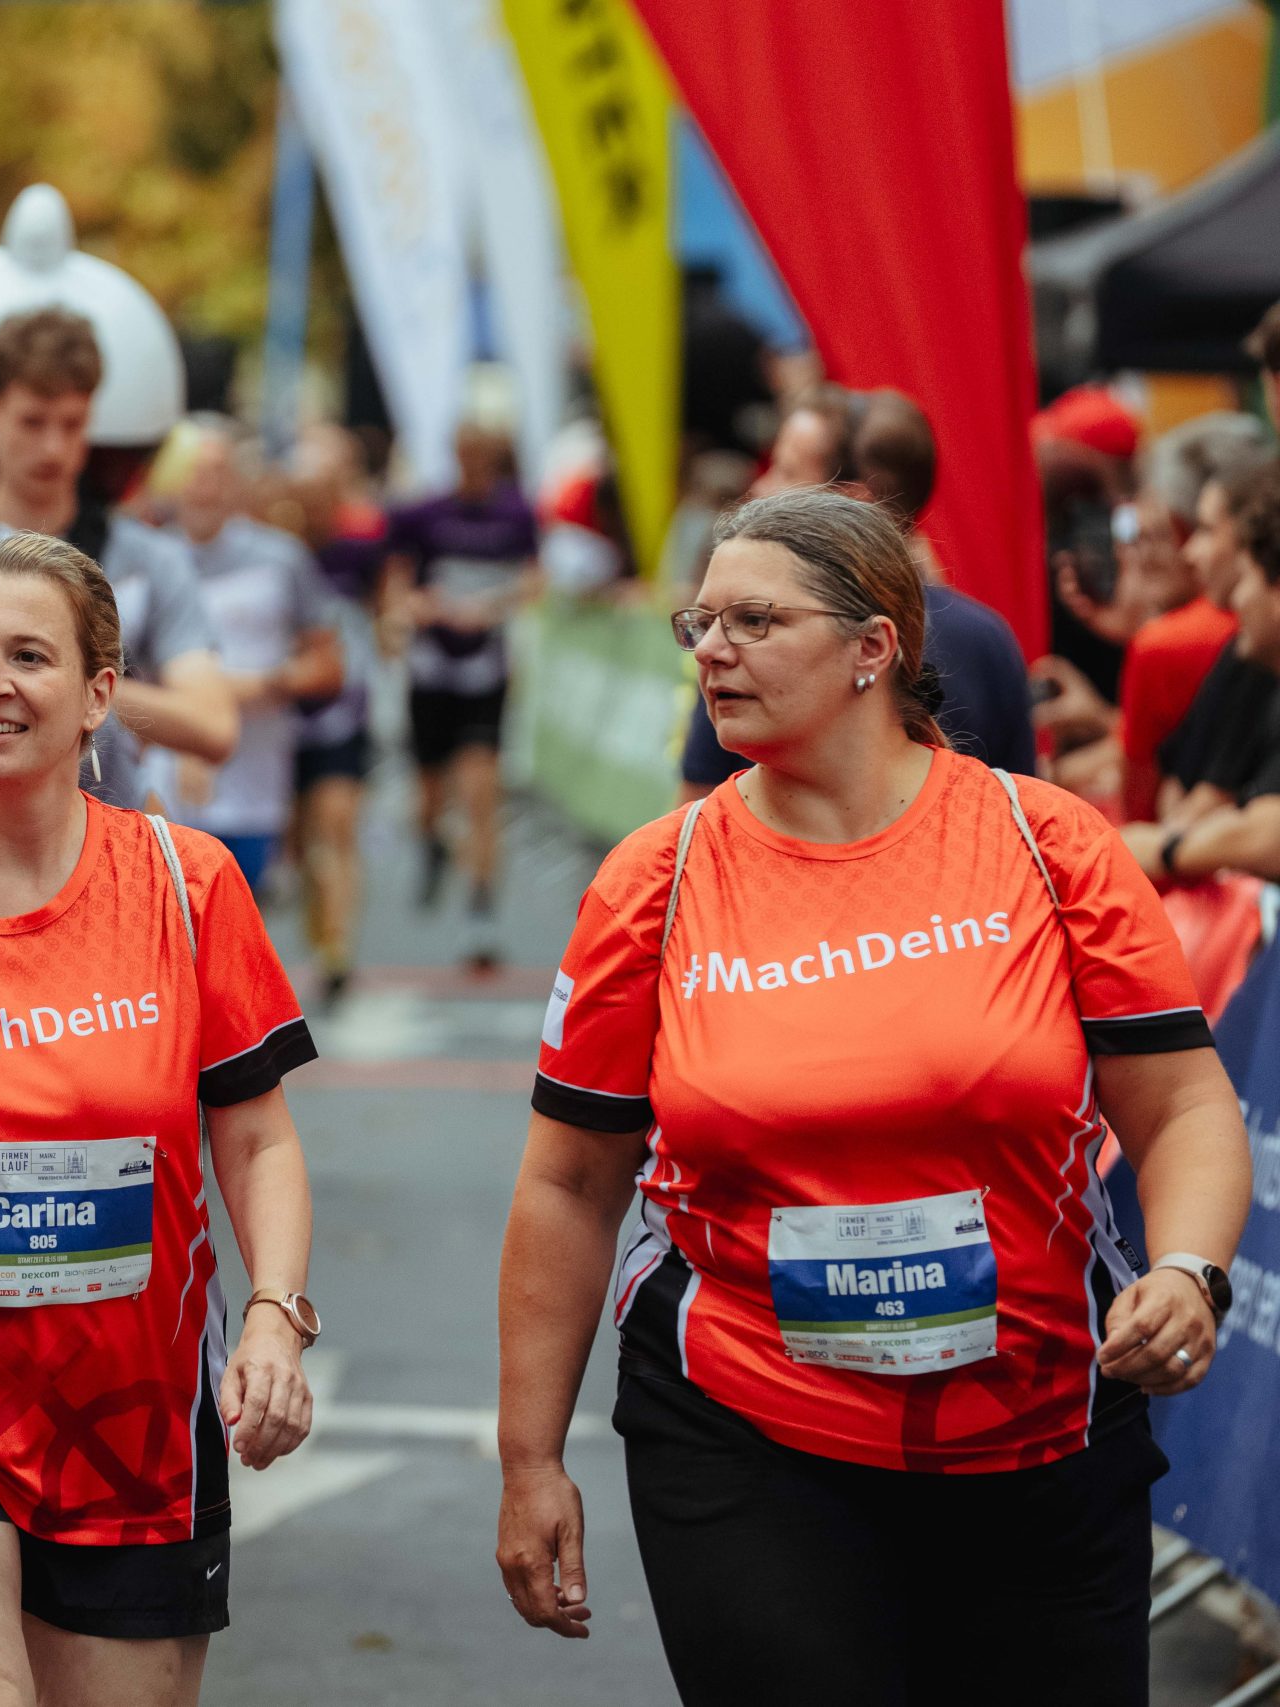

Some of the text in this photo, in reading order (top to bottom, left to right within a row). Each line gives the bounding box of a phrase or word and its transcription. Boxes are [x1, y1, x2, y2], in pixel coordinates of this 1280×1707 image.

[680, 911, 1012, 1000] #MachDeins
[1, 1152, 29, 1160] FIRMEN
[1, 1161, 29, 1172] LAUF
[838, 1214, 866, 1224] FIRMEN
[839, 1226, 866, 1237] LAUF
[29, 1235, 57, 1249] 805
[21, 1270, 60, 1279] Dexcom
[825, 1261, 946, 1296] Marina
[28, 1285, 43, 1293] dm
[875, 1300, 905, 1317] 463
